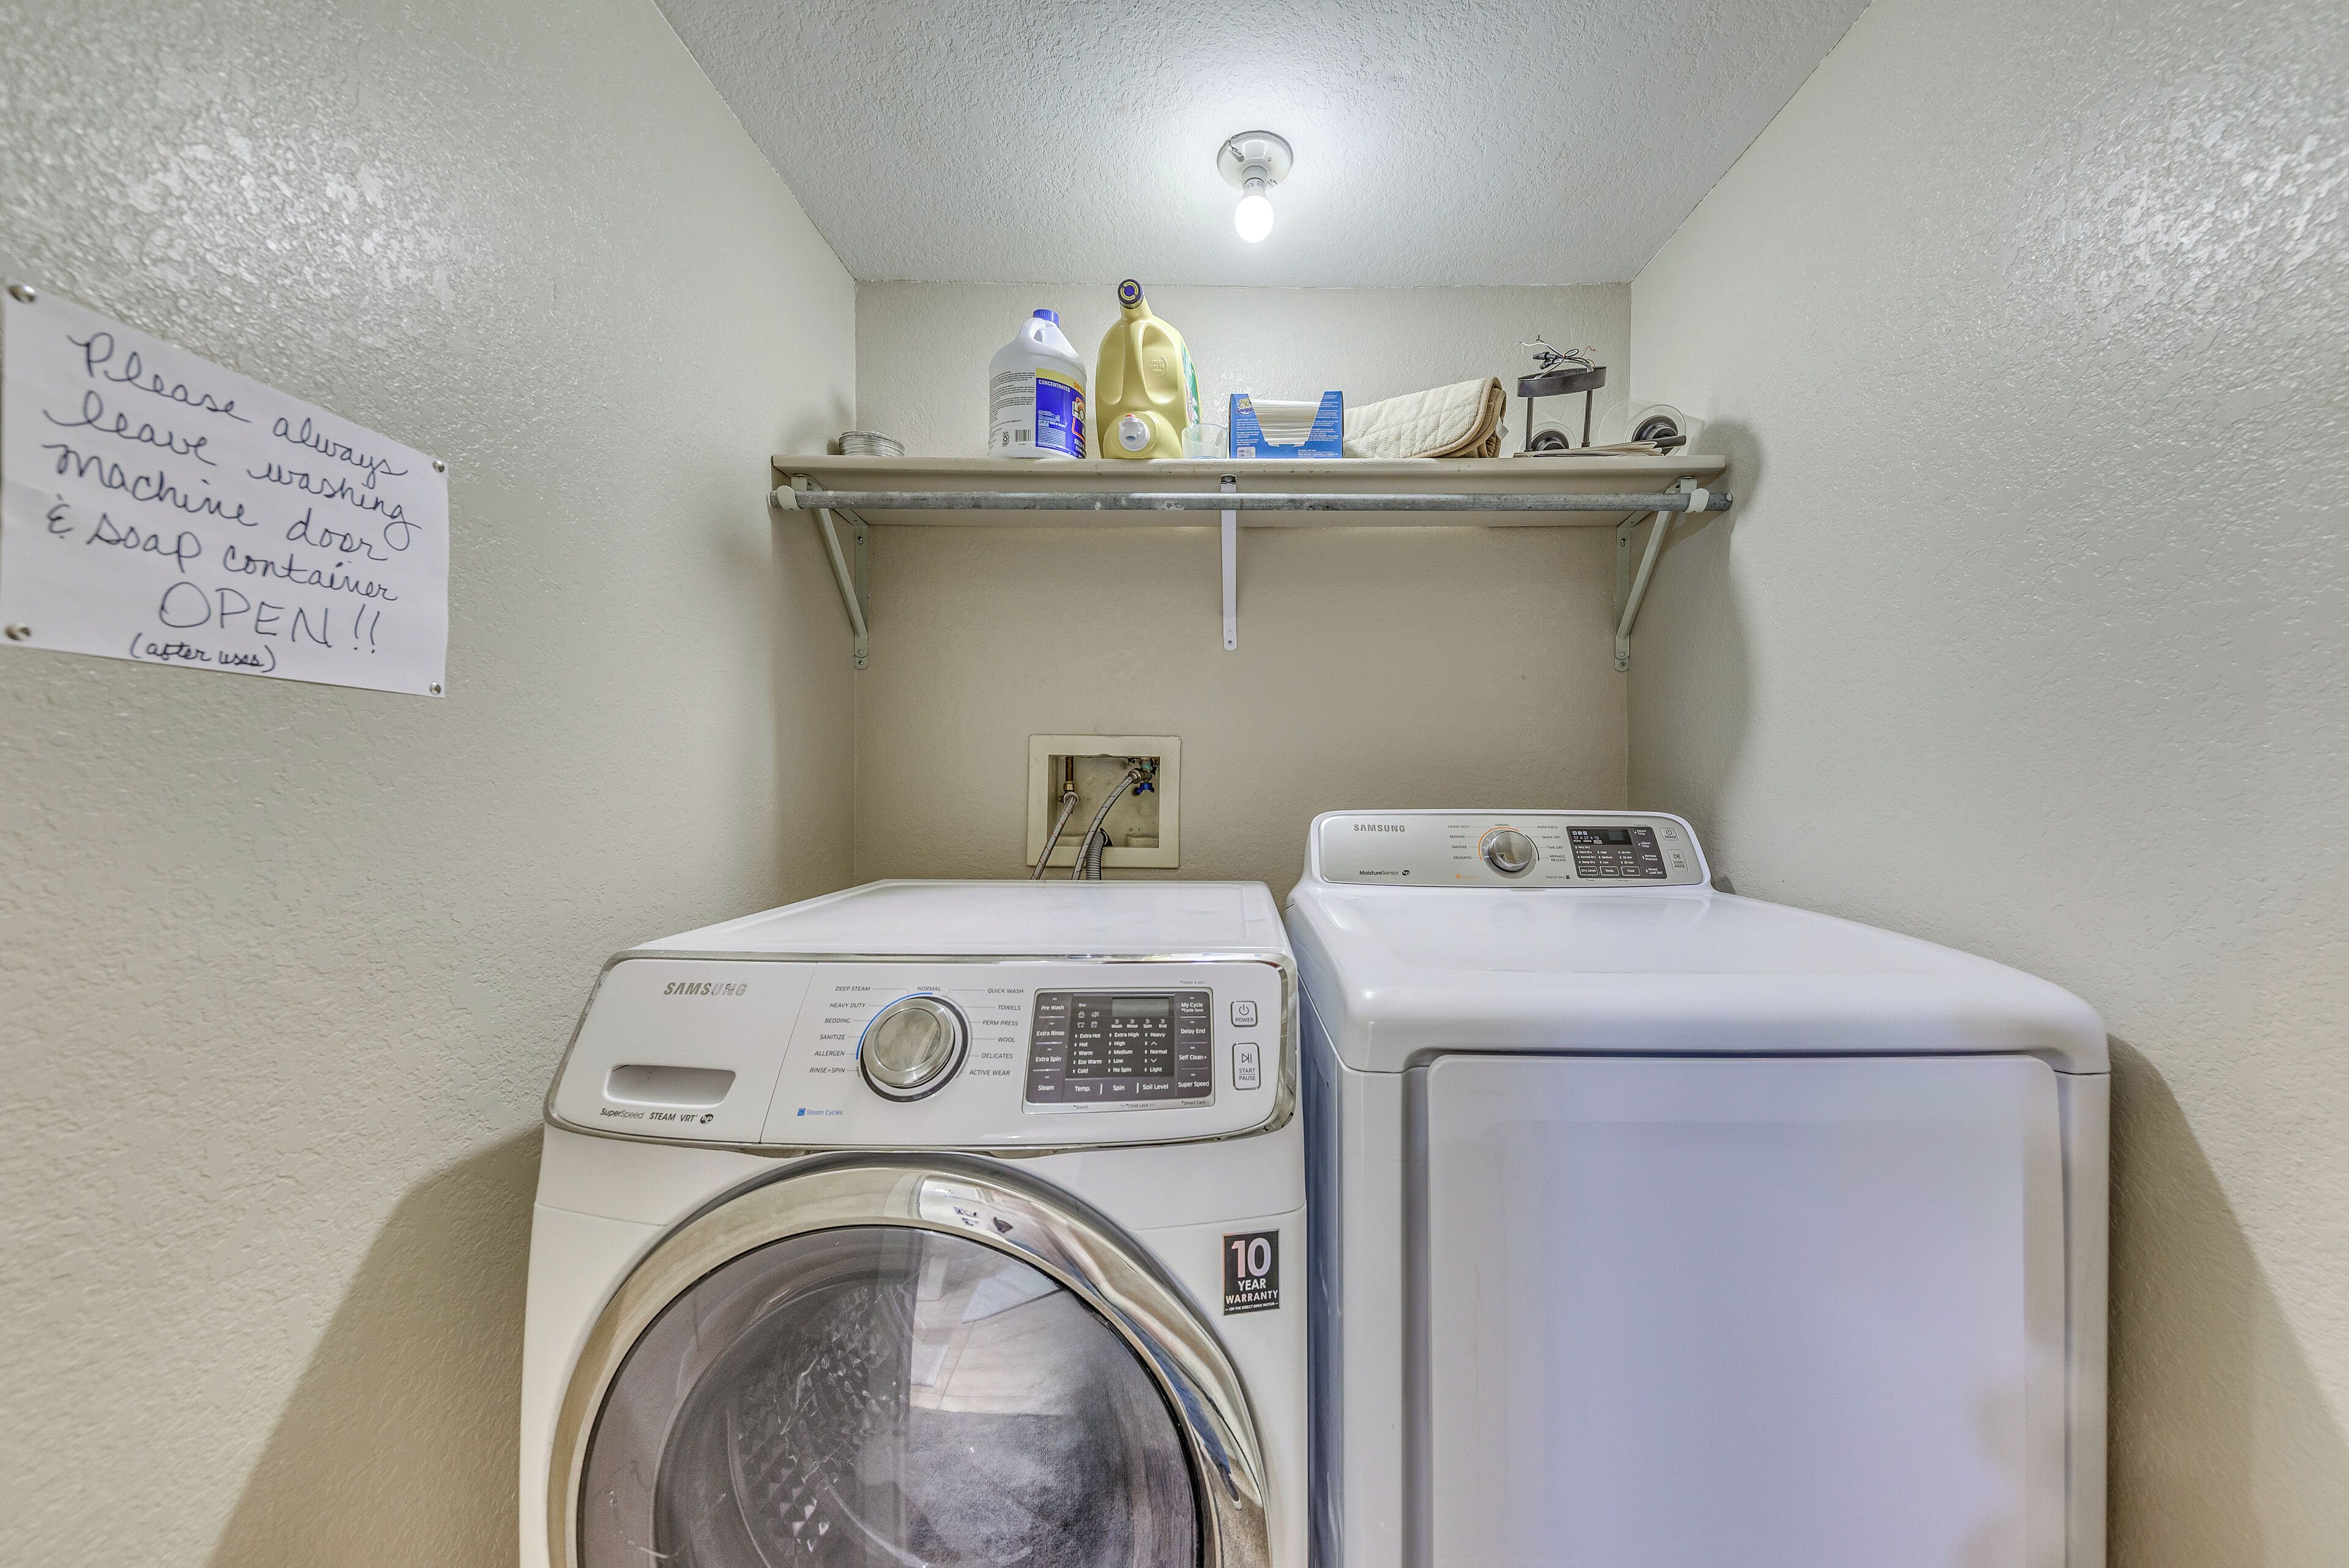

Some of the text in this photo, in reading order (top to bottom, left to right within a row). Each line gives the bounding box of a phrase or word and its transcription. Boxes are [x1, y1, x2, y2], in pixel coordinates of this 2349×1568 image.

[1038, 379, 1071, 392] CONCENTRATED
[67, 332, 408, 489] Please always
[42, 390, 422, 551] leave washing
[286, 507, 388, 561] door
[86, 513, 201, 573] soap
[224, 545, 398, 601] container
[664, 982, 748, 996] SAMSUNG
[649, 1112, 677, 1121] STEAM
[1231, 1238, 1271, 1278] 10
[1225, 1290, 1278, 1304] WARRANTY
[1238, 1278, 1266, 1291] YEAR
